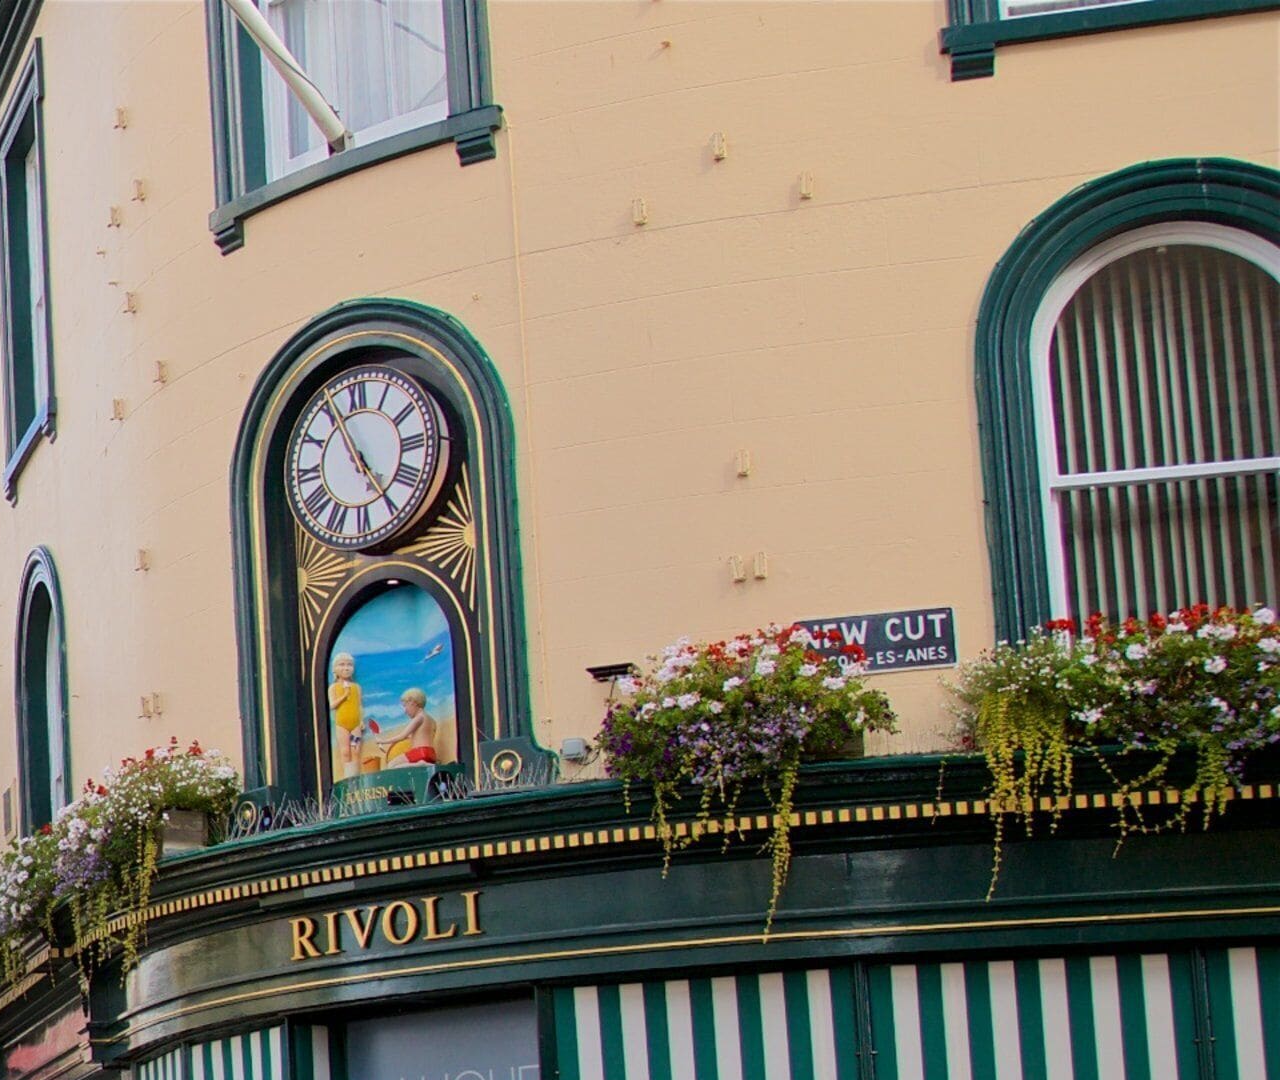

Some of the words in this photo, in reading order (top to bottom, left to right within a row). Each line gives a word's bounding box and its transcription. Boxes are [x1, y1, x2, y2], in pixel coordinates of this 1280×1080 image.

[808, 621, 868, 649] NEW
[885, 614, 947, 642] CUT
[288, 890, 483, 961] RIVOLI
